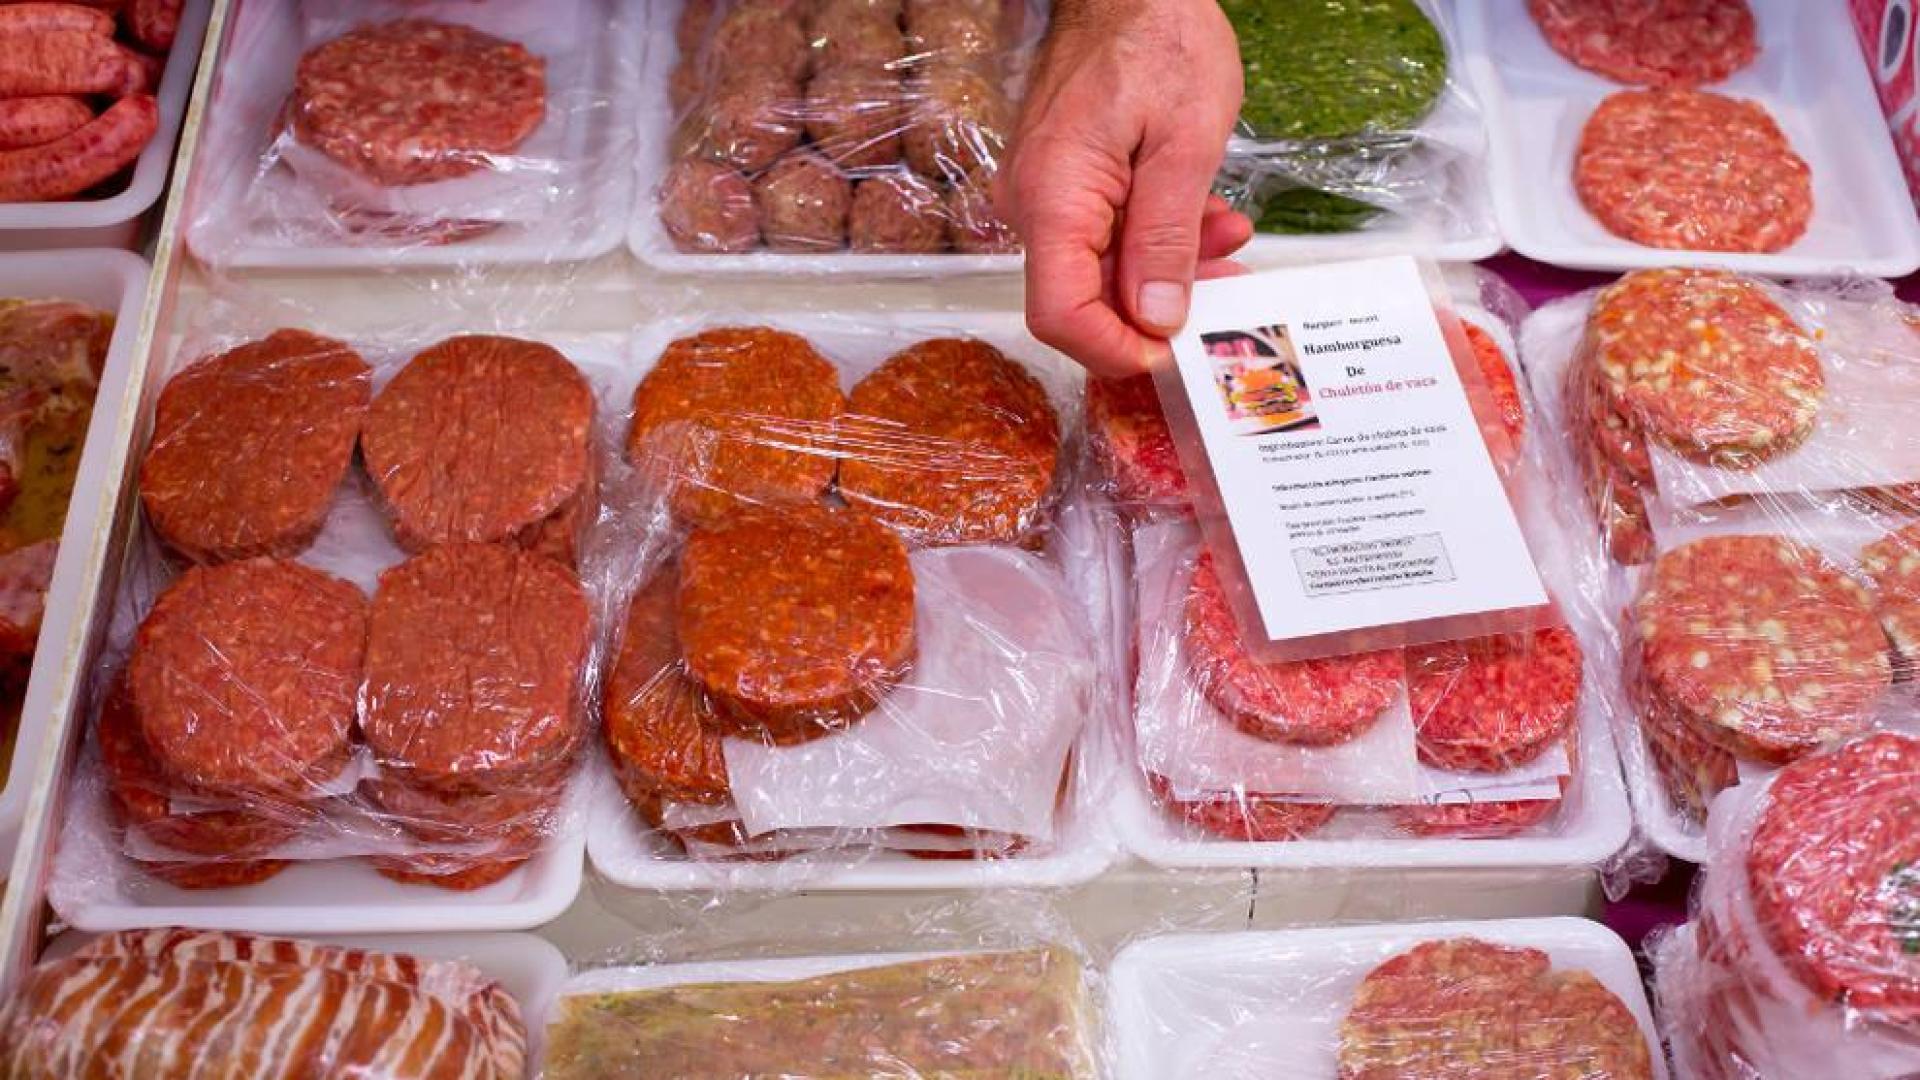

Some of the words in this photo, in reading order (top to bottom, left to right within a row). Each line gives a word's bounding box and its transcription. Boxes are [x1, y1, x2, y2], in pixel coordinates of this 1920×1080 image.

[1304, 335, 1402, 355] Hamburguesa
[1346, 365, 1366, 378] De
[1318, 382, 1382, 399] Chuletón
[1385, 378, 1403, 392] de
[1406, 376, 1438, 388] vaca
